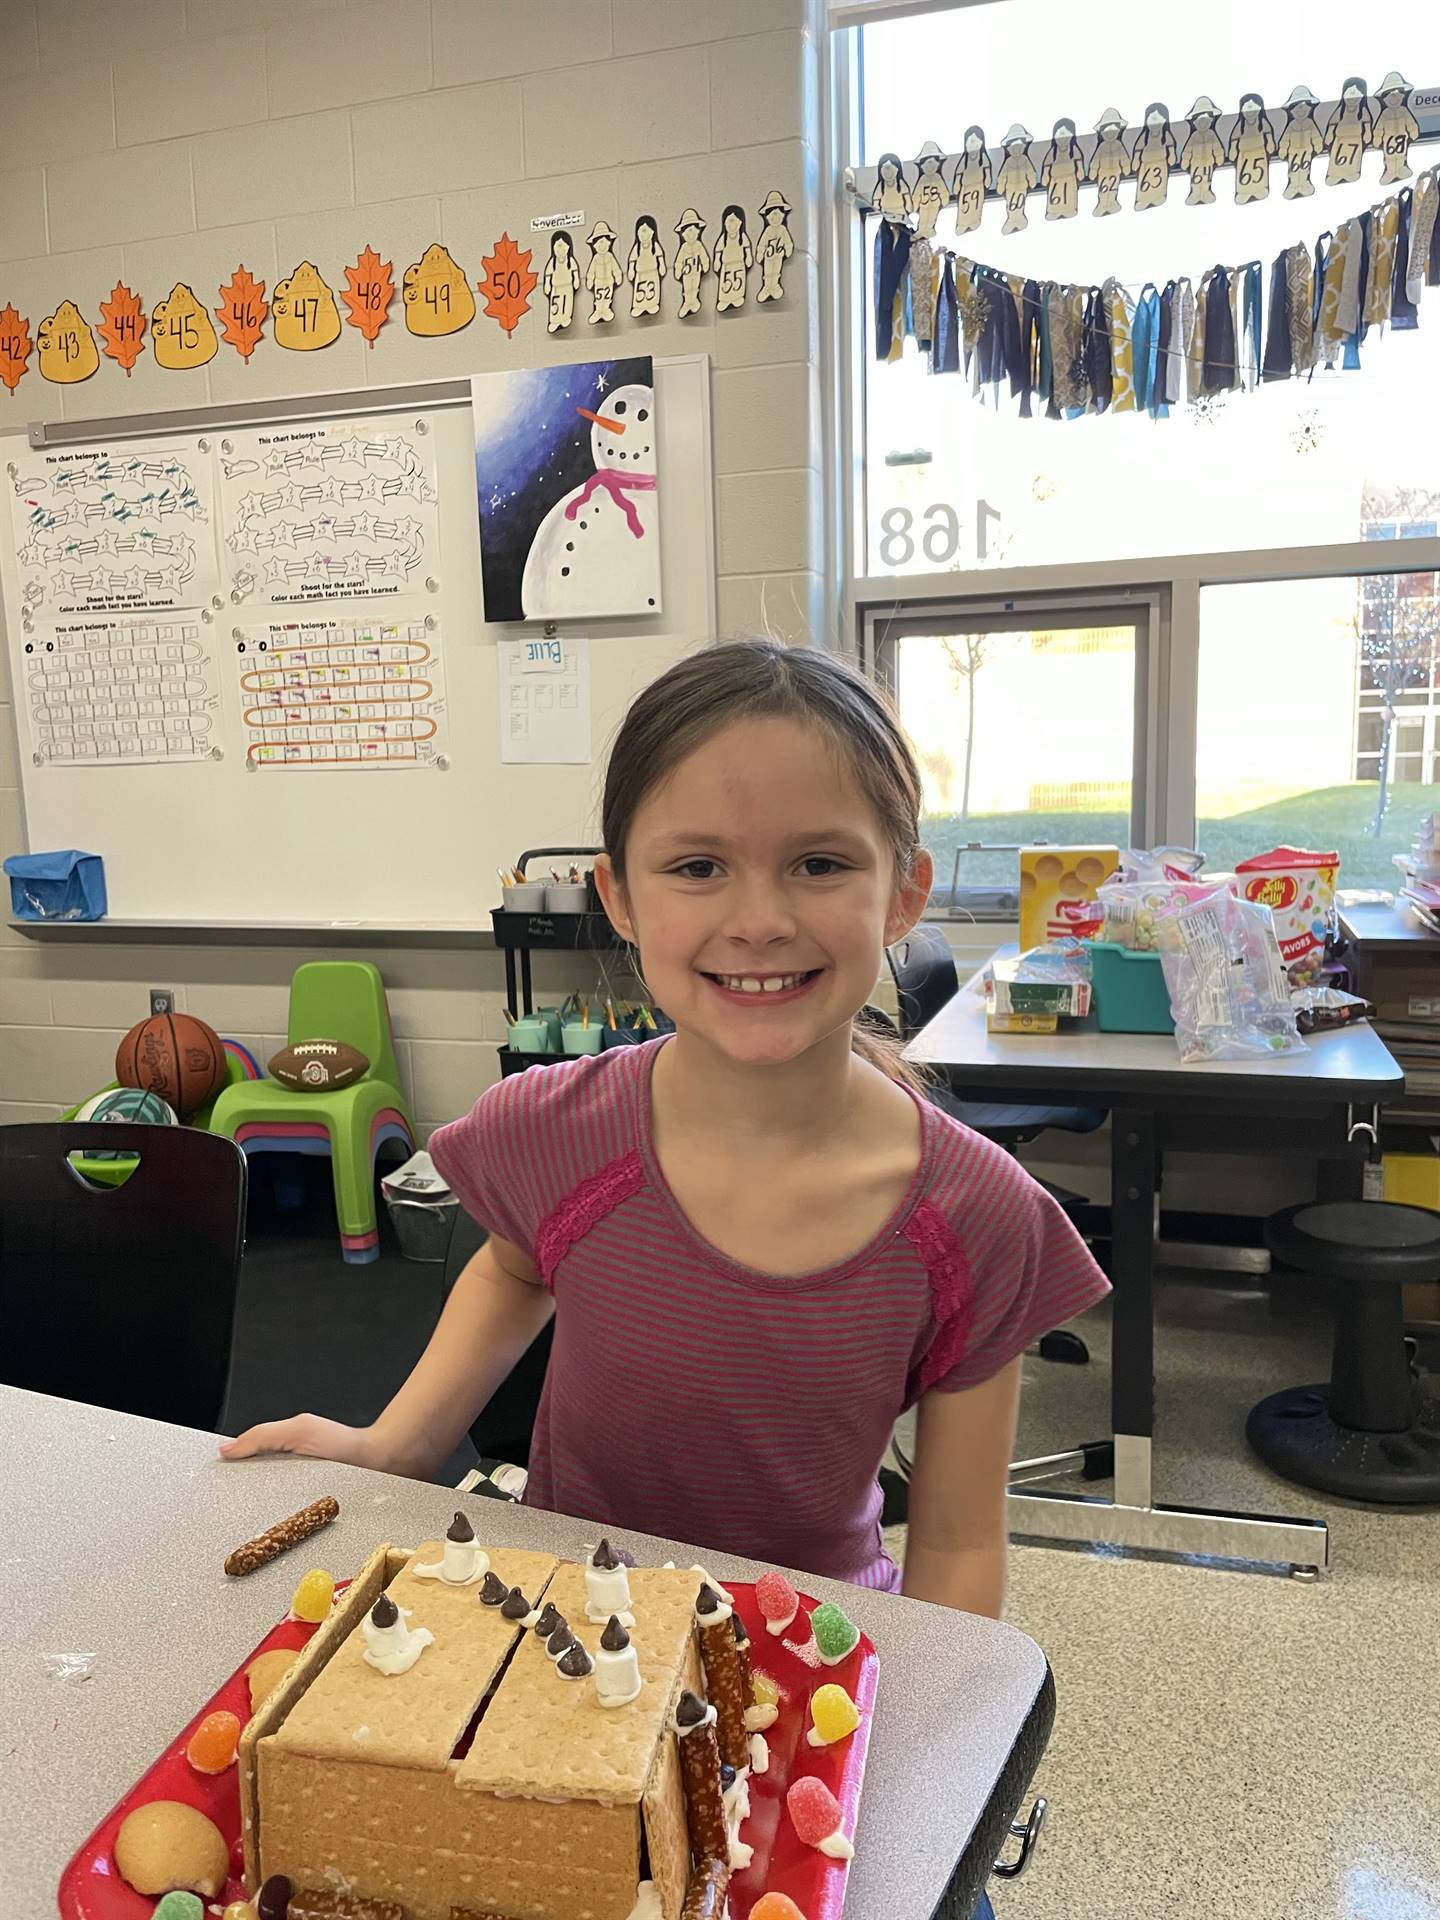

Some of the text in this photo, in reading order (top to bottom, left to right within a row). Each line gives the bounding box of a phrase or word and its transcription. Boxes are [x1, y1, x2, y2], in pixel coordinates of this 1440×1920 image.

[1415, 95, 1440, 106] Dec
[1290, 151, 1310, 173] 66
[1334, 143, 1358, 166] 67
[1141, 167, 1163, 192] 63
[1192, 165, 1211, 184] 64
[1239, 157, 1265, 185] 65
[921, 186, 939, 205] 58
[1050, 183, 1068, 205] 61
[1100, 175, 1118, 194] 62
[962, 190, 980, 214] 59
[1008, 192, 1025, 211] 60
[764, 237, 785, 258] 56
[683, 254, 701, 275] 54
[493, 270, 521, 301] 50
[636, 280, 656, 302] 53
[721, 269, 743, 294] 55
[357, 281, 382, 312] 48
[425, 283, 451, 315] 49
[595, 286, 611, 300] 52
[233, 302, 257, 330] 46
[294, 298, 319, 334] 47
[551, 294, 567, 316] 51
[114, 314, 136, 342] 44
[170, 314, 199, 350] 45
[1, 335, 23, 362] 42
[58, 336, 80, 363] 43
[272, 435, 289, 443] chart
[291, 432, 317, 440] belongs
[325, 590, 338, 598] fact
[76, 603, 90, 611] each
[85, 623, 109, 631] belongs
[301, 622, 327, 630] belongs
[526, 641, 562, 664] BLUE
[1263, 877, 1286, 895] Jelly
[1283, 936, 1311, 954] AVORS
